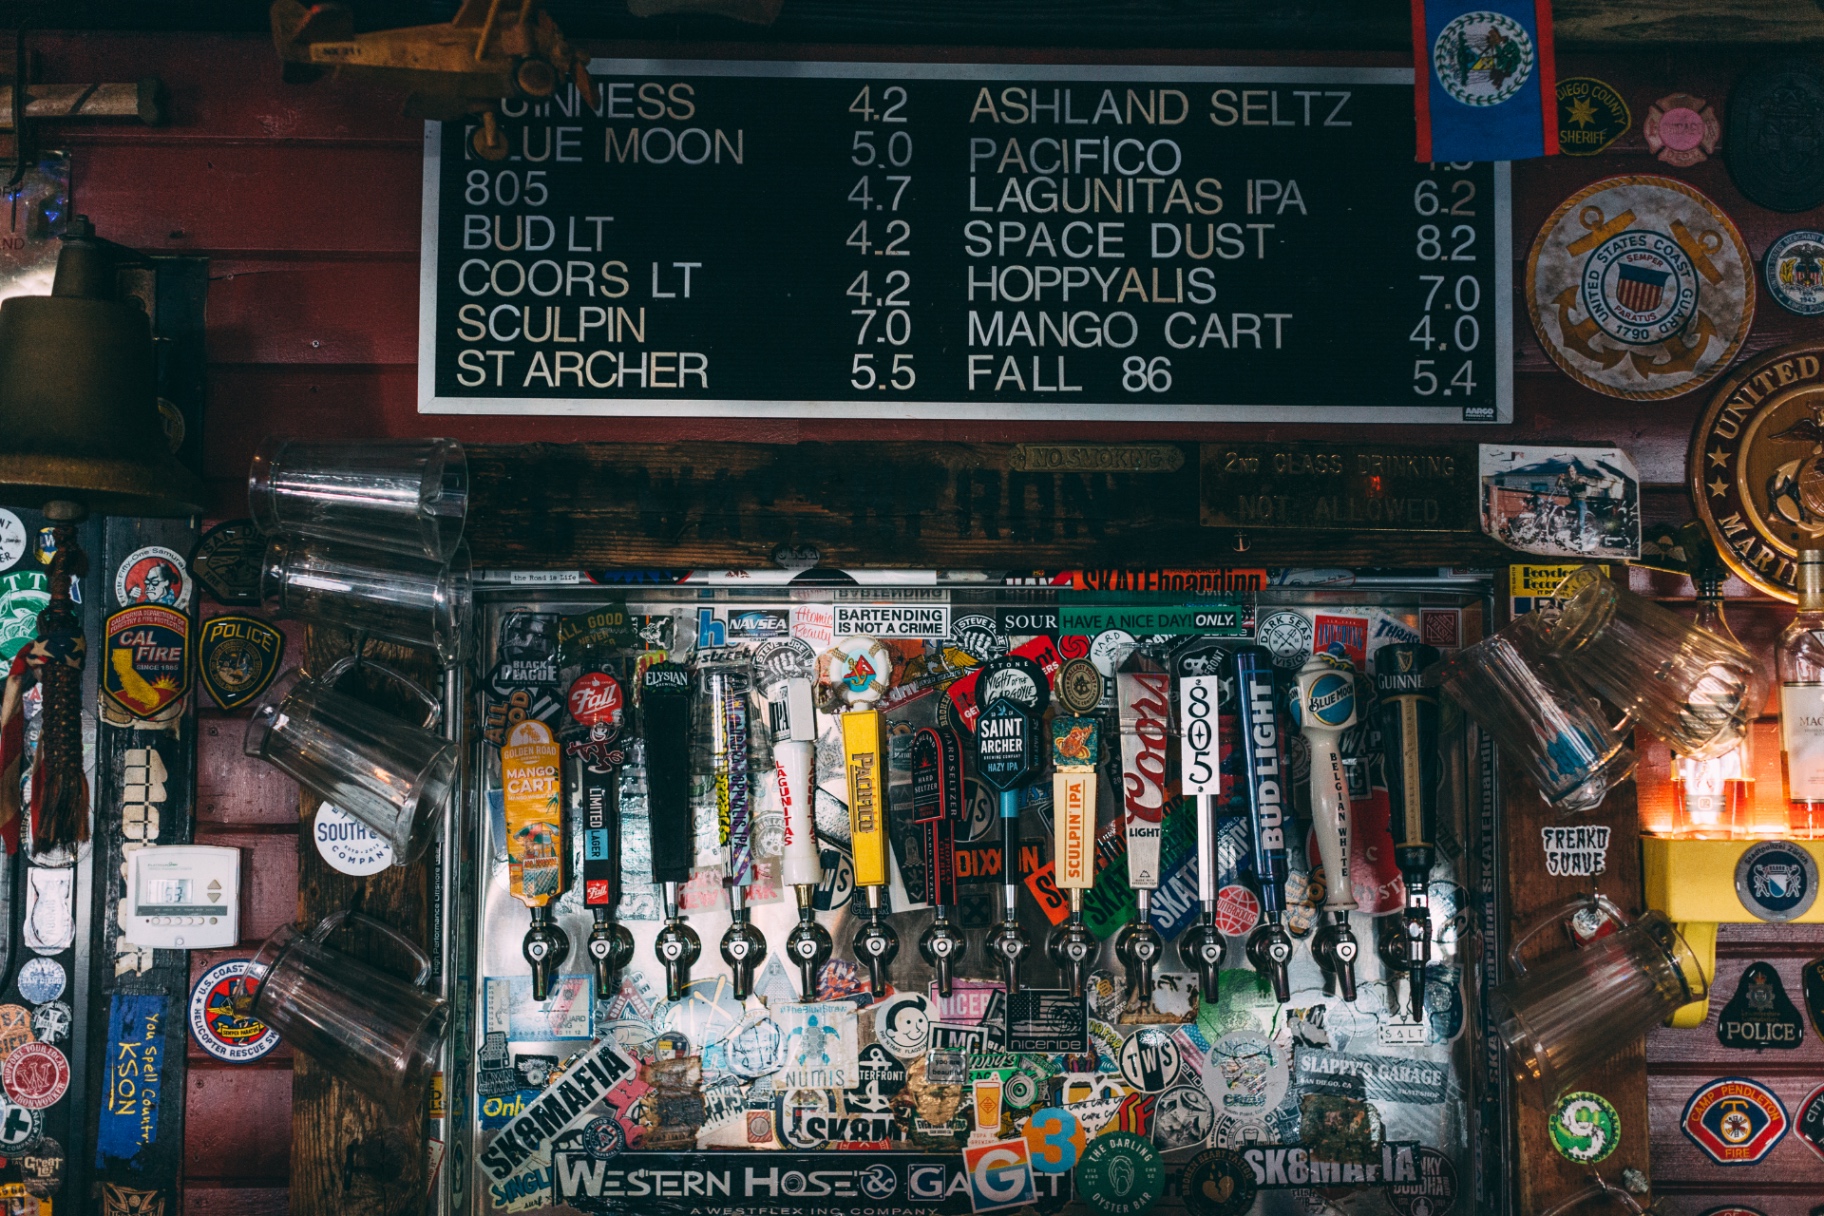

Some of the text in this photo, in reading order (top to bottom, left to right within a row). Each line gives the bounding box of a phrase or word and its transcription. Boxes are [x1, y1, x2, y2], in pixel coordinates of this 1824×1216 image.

[500, 83, 695, 119] UINNESS
[849, 85, 908, 124] 4.2
[969, 87, 1352, 127] ASHLAND SELTZ
[1591, 85, 1627, 126] COUNTY
[605, 128, 744, 165] MOON
[851, 130, 913, 169] 5.0
[1559, 129, 1607, 145] SHERIFF
[970, 136, 1182, 175] PACIFICO
[464, 170, 549, 207] 805
[848, 175, 912, 211] 4.7
[970, 177, 1308, 217] LAGUNITAS IPA
[1414, 180, 1477, 217] 6.2
[462, 215, 614, 252] BUD LT
[846, 220, 911, 256] 4.2
[963, 220, 1275, 260] SPACE DUST
[1415, 224, 1477, 262] 8.2
[1626, 252, 1664, 268] SEMPER
[458, 259, 702, 299] COORS LT
[846, 270, 911, 307] 4.2
[968, 265, 1217, 304] HOPPYALIS
[1418, 275, 1481, 312] 7.0
[1586, 234, 1694, 336] UNITED STATES COAST GUARD
[456, 303, 646, 343] SCULPIN
[851, 309, 912, 346] 7.0
[1613, 303, 1659, 322] PARATUS
[968, 310, 1292, 350] MANGO CART
[1408, 315, 1480, 352] 4.0
[1614, 323, 1650, 341] 1790
[456, 350, 709, 389] ST ARCHER
[850, 353, 916, 391] 5.5
[968, 354, 1173, 393] FALL 86
[1412, 360, 1478, 396] 5.4
[1713, 354, 1821, 441] UNITED
[1033, 445, 1162, 470] NO SMOKING
[1224, 452, 1455, 478] 2ND CLASS DRINKING
[1238, 495, 1440, 523] NOT ALLOWED
[529, 573, 548, 581] Road
[559, 573, 577, 581] Life
[587, 612, 623, 629] GOOD
[728, 617, 788, 631] NAVSEA
[795, 606, 833, 625] Atomic
[838, 609, 943, 622] BARTENDING
[838, 622, 943, 634] IS NOT A CRIME
[958, 617, 989, 629] STEVE
[1005, 614, 1059, 629] SOUR
[1063, 614, 1234, 628] HAVE A NICE DAY! ONLY.
[1260, 616, 1312, 644] DARK SEAS
[119, 630, 158, 646] CAL
[209, 623, 275, 653] POLICE
[792, 623, 832, 646] Beauty
[1095, 632, 1121, 657] HARD
[135, 646, 183, 662] FIRE
[512, 660, 548, 670] BLACK
[756, 641, 781, 664] STEVE
[989, 660, 1029, 669] STONE
[645, 670, 689, 688] ELYSIAN
[1377, 673, 1425, 691] GUINNE
[571, 684, 618, 715] Fall
[1308, 688, 1335, 714] BLUE
[772, 700, 790, 732] IPA
[980, 718, 1023, 738] SAINT
[980, 738, 1023, 754] ARCHER
[1123, 673, 1170, 824] Coors
[1187, 686, 1213, 785] 805
[504, 745, 557, 760] GOLDEN ROAD
[987, 761, 1019, 773] HAZY IPA
[1250, 680, 1285, 850] BUD LIGHT
[506, 765, 556, 779] MANGO
[507, 777, 556, 794] CART
[914, 782, 938, 793] SELTZER
[917, 774, 934, 783] HARD
[775, 760, 795, 847] LAGUNITAS
[850, 751, 876, 833] PACIFICO
[948, 764, 958, 816] SELTZER
[588, 787, 603, 828] LIMITED
[1329, 753, 1348, 878] BELGIAN WHITE
[317, 822, 366, 842] SOUTH
[588, 829, 601, 858] LAGER
[1067, 782, 1082, 878] SCULPIN IPA
[1129, 827, 1160, 838] LIGHT
[331, 844, 392, 865] COMPANY
[954, 845, 1040, 878] DIXXN
[1549, 852, 1605, 875] SUAVE
[587, 884, 607, 898] Fall
[198, 964, 245, 995] U.S. COAST
[194, 1008, 266, 1058] HELICOPTER RESCUE
[1385, 1028, 1424, 1039] SALT
[1726, 1021, 1796, 1041] POLICE
[143, 1013, 161, 1083] You Spell
[1127, 1041, 1174, 1078] TWS
[4, 1044, 66, 1085] SUPPORT YOUR LOCAL
[114, 1042, 142, 1115] KSON
[786, 1068, 846, 1088] NUMIS
[860, 1069, 904, 1082] TERFRONT
[1300, 1054, 1442, 1087] SLAPPY'S GARAGE
[14, 1082, 67, 1109] IRONWORKER
[1690, 1084, 1781, 1122] CAMP PENDLETON
[479, 1044, 632, 1180] SK8MAFIA
[1031, 1111, 1077, 1170] 3
[1087, 1137, 1155, 1163] THE DARLING
[1724, 1148, 1751, 1159] FIRE
[24, 1155, 64, 1170] Great
[555, 1153, 859, 1198] WESTERN HOSE
[974, 1148, 1026, 1201] G
[1181, 1161, 1199, 1197] BROKEN
[1198, 1150, 1226, 1165] HEART
[690, 1206, 939, 1216] A WESTFLEX COMPANY
[1091, 1190, 1153, 1214] OYSTER BAR
